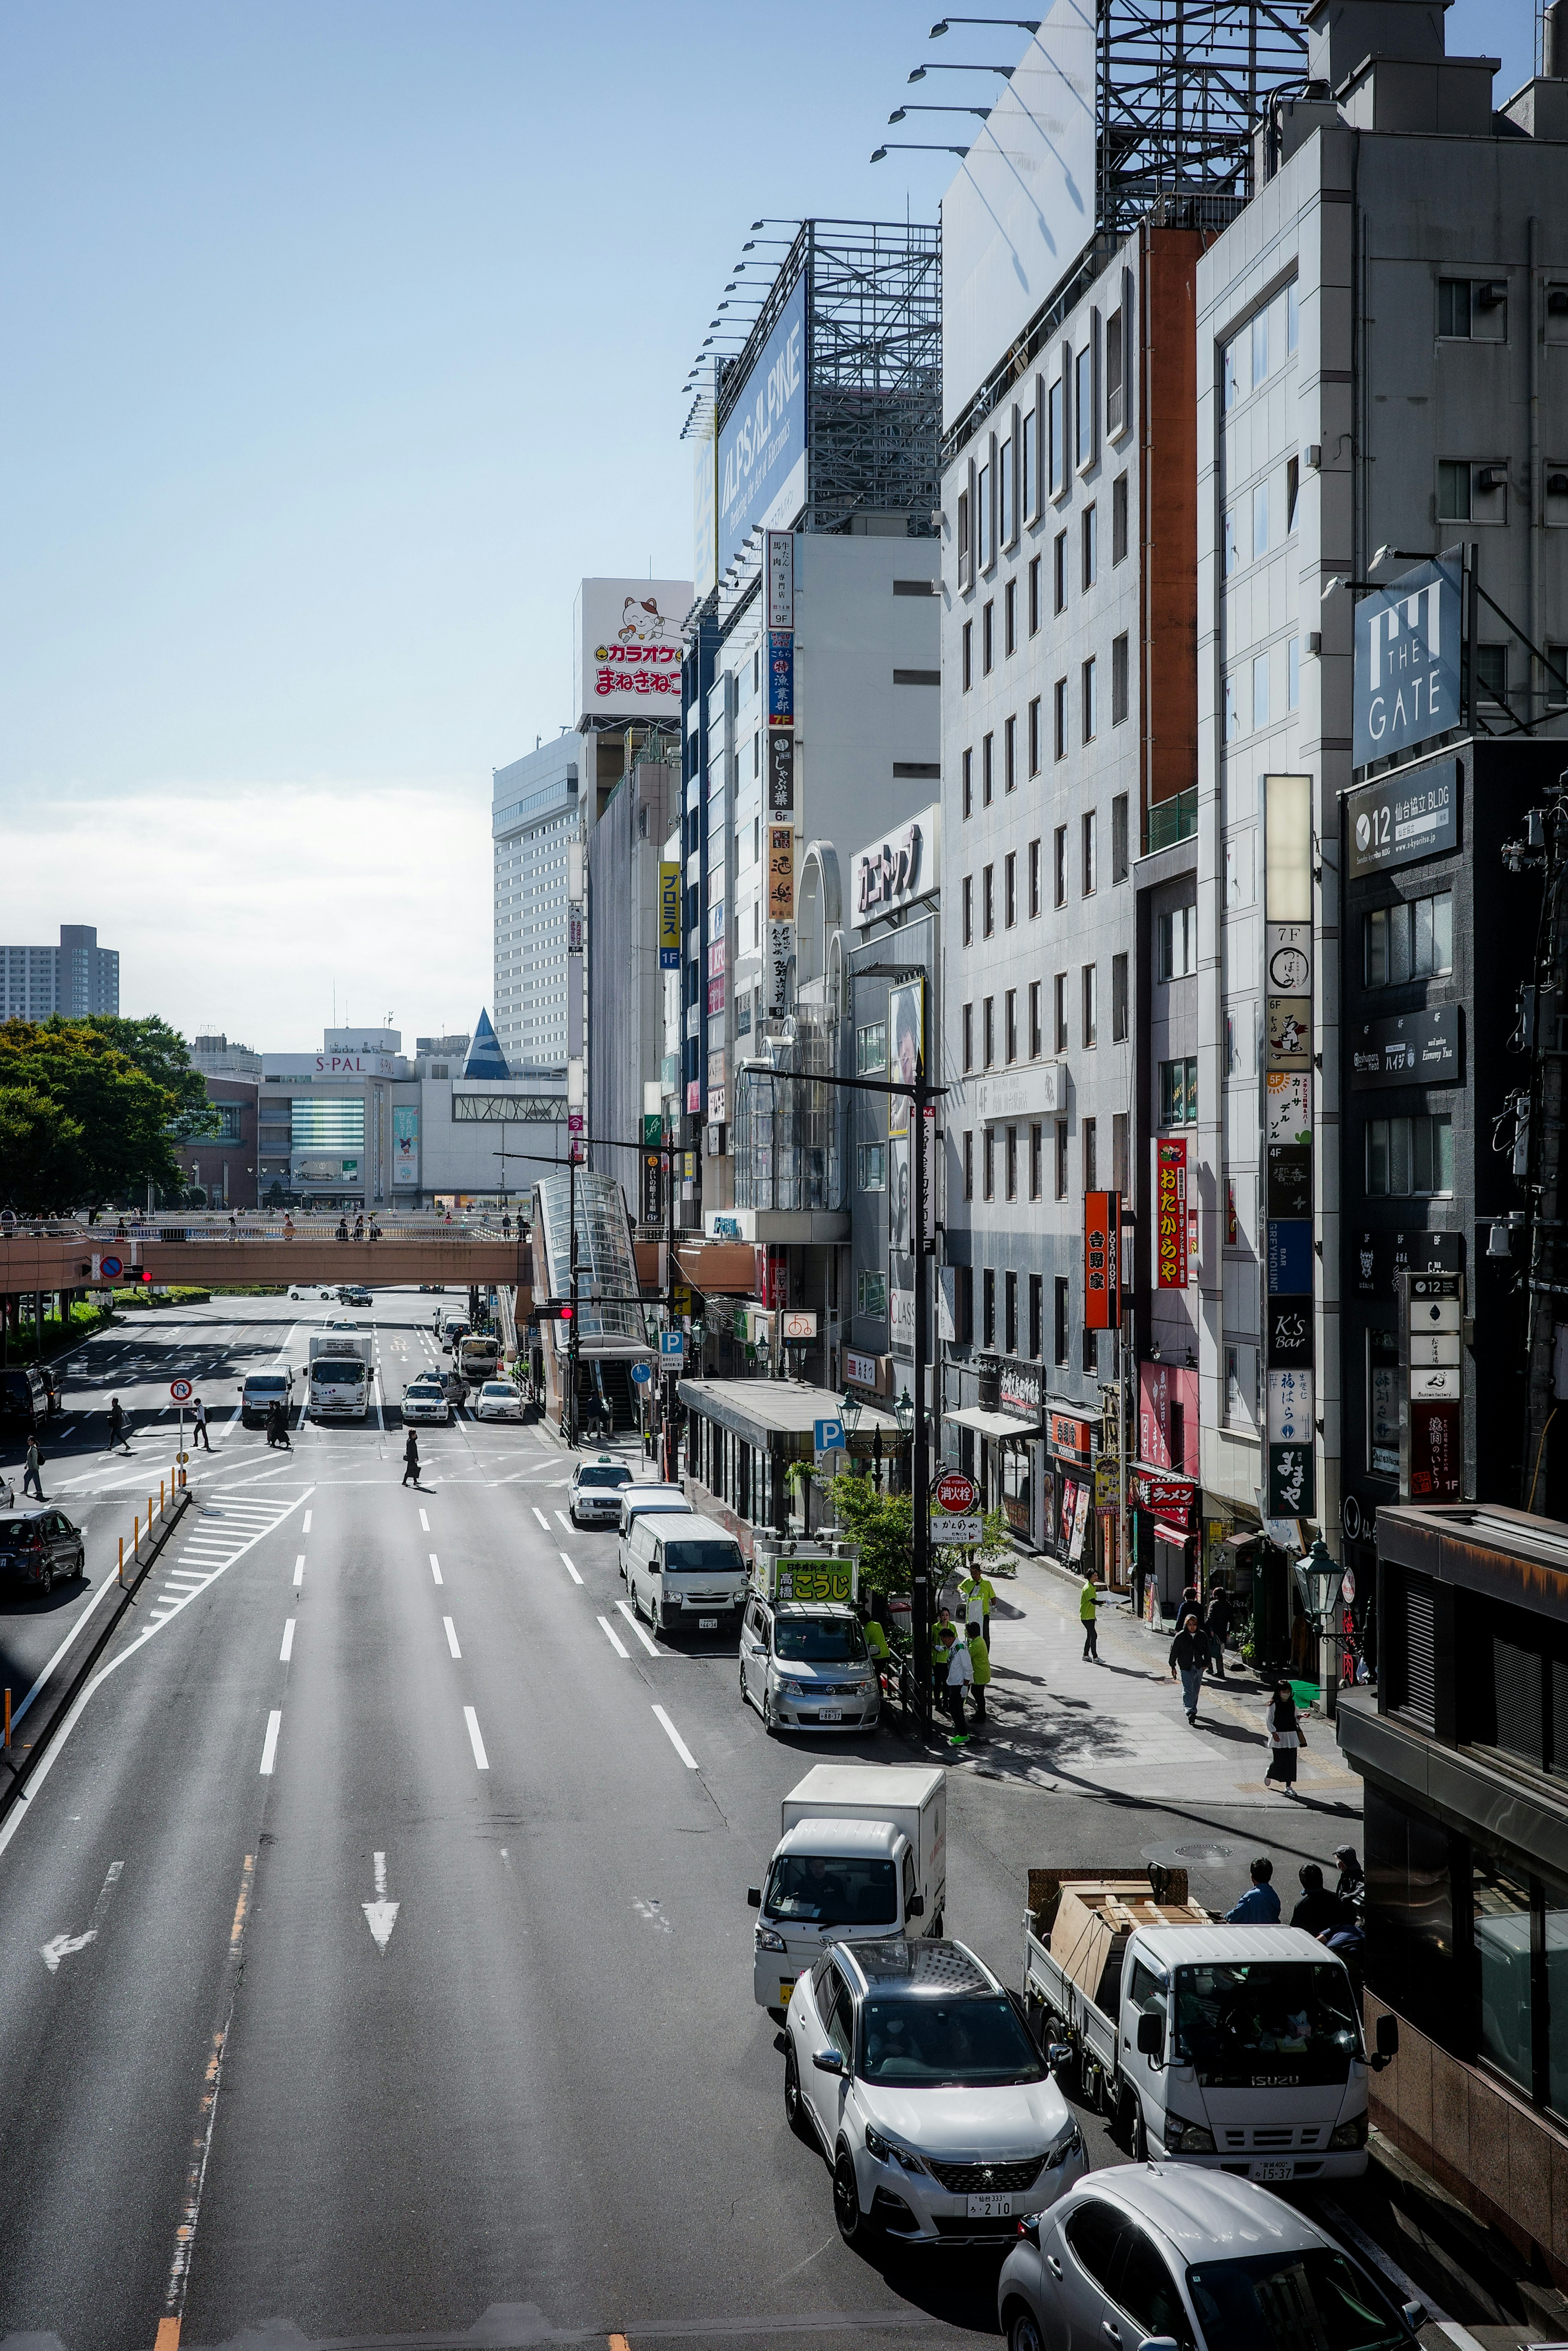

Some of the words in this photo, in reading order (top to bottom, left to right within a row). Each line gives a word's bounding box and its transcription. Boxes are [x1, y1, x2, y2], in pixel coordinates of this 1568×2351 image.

[773, 541, 781, 566] 馬肉
[609, 646, 675, 663] カラオケ
[1389, 638, 1419, 675] THE
[774, 674, 789, 713] 漁業部
[1369, 668, 1440, 740] GATE
[774, 716, 790, 724] 7F
[774, 755, 788, 806] しゃぶ葉
[1395, 793, 1426, 822] 仙台協立
[1428, 785, 1449, 810] BLDG
[775, 811, 787, 821] 6F
[1372, 806, 1391, 846] 12
[1382, 846, 1391, 857] BLDG
[858, 824, 922, 913] カニトップ
[664, 875, 677, 935] プロミス
[1278, 928, 1300, 941] 7F
[662, 953, 677, 964] 1F
[1283, 951, 1295, 984] つぼみ
[1270, 1000, 1281, 1009] 6F
[1398, 1019, 1403, 1029] 4F
[1434, 1012, 1441, 1023] 4F
[1364, 1026, 1369, 1035] 4F
[1386, 1053, 1405, 1071] ハイジ
[1423, 1049, 1441, 1062] Eimmy
[1442, 1047, 1452, 1058] Yua
[316, 1058, 366, 1071] S-PAL
[380, 1058, 394, 1074] S-PAL
[1270, 1075, 1281, 1084] 5F
[979, 1086, 987, 1113] 4F
[1292, 1078, 1301, 1106] カーサ
[1281, 1103, 1290, 1122] デル
[645, 1118, 661, 1140] エイブル
[1270, 1122, 1280, 1139] ソル
[1270, 1148, 1281, 1157] 4F
[1160, 1168, 1177, 1282] おたからや
[1364, 1234, 1370, 1243] 3F
[1397, 1235, 1403, 1244] BF
[1434, 1236, 1440, 1245] BF
[1088, 1231, 1105, 1290] 吉野家
[1269, 1223, 1278, 1291] GREYHOUND
[1428, 1281, 1441, 1293] 12
[493, 1296, 498, 1305] P
[1275, 1314, 1305, 1336] K's
[668, 1335, 679, 1352] P
[1276, 1336, 1305, 1348] Bar
[1281, 1372, 1295, 1420] 福はら
[823, 1423, 839, 1447] P
[1057, 1419, 1076, 1448] 吉野家
[1058, 1445, 1076, 1460] YOSHINOYA
[1430, 1417, 1443, 1490] 焼肉のいとう
[1277, 1452, 1304, 1510] ままや
[1445, 1480, 1459, 1490] 1F
[940, 1486, 971, 1501] 消火栓
[1153, 1487, 1192, 1502] ラーメン
[787, 1562, 828, 1573] 日本維新の会
[779, 1573, 793, 1599] 高橋
[796, 1574, 850, 1600] こうじ
[1252, 2076, 1299, 2085] ISUZU
[1263, 2168, 1292, 2180] 15-37
